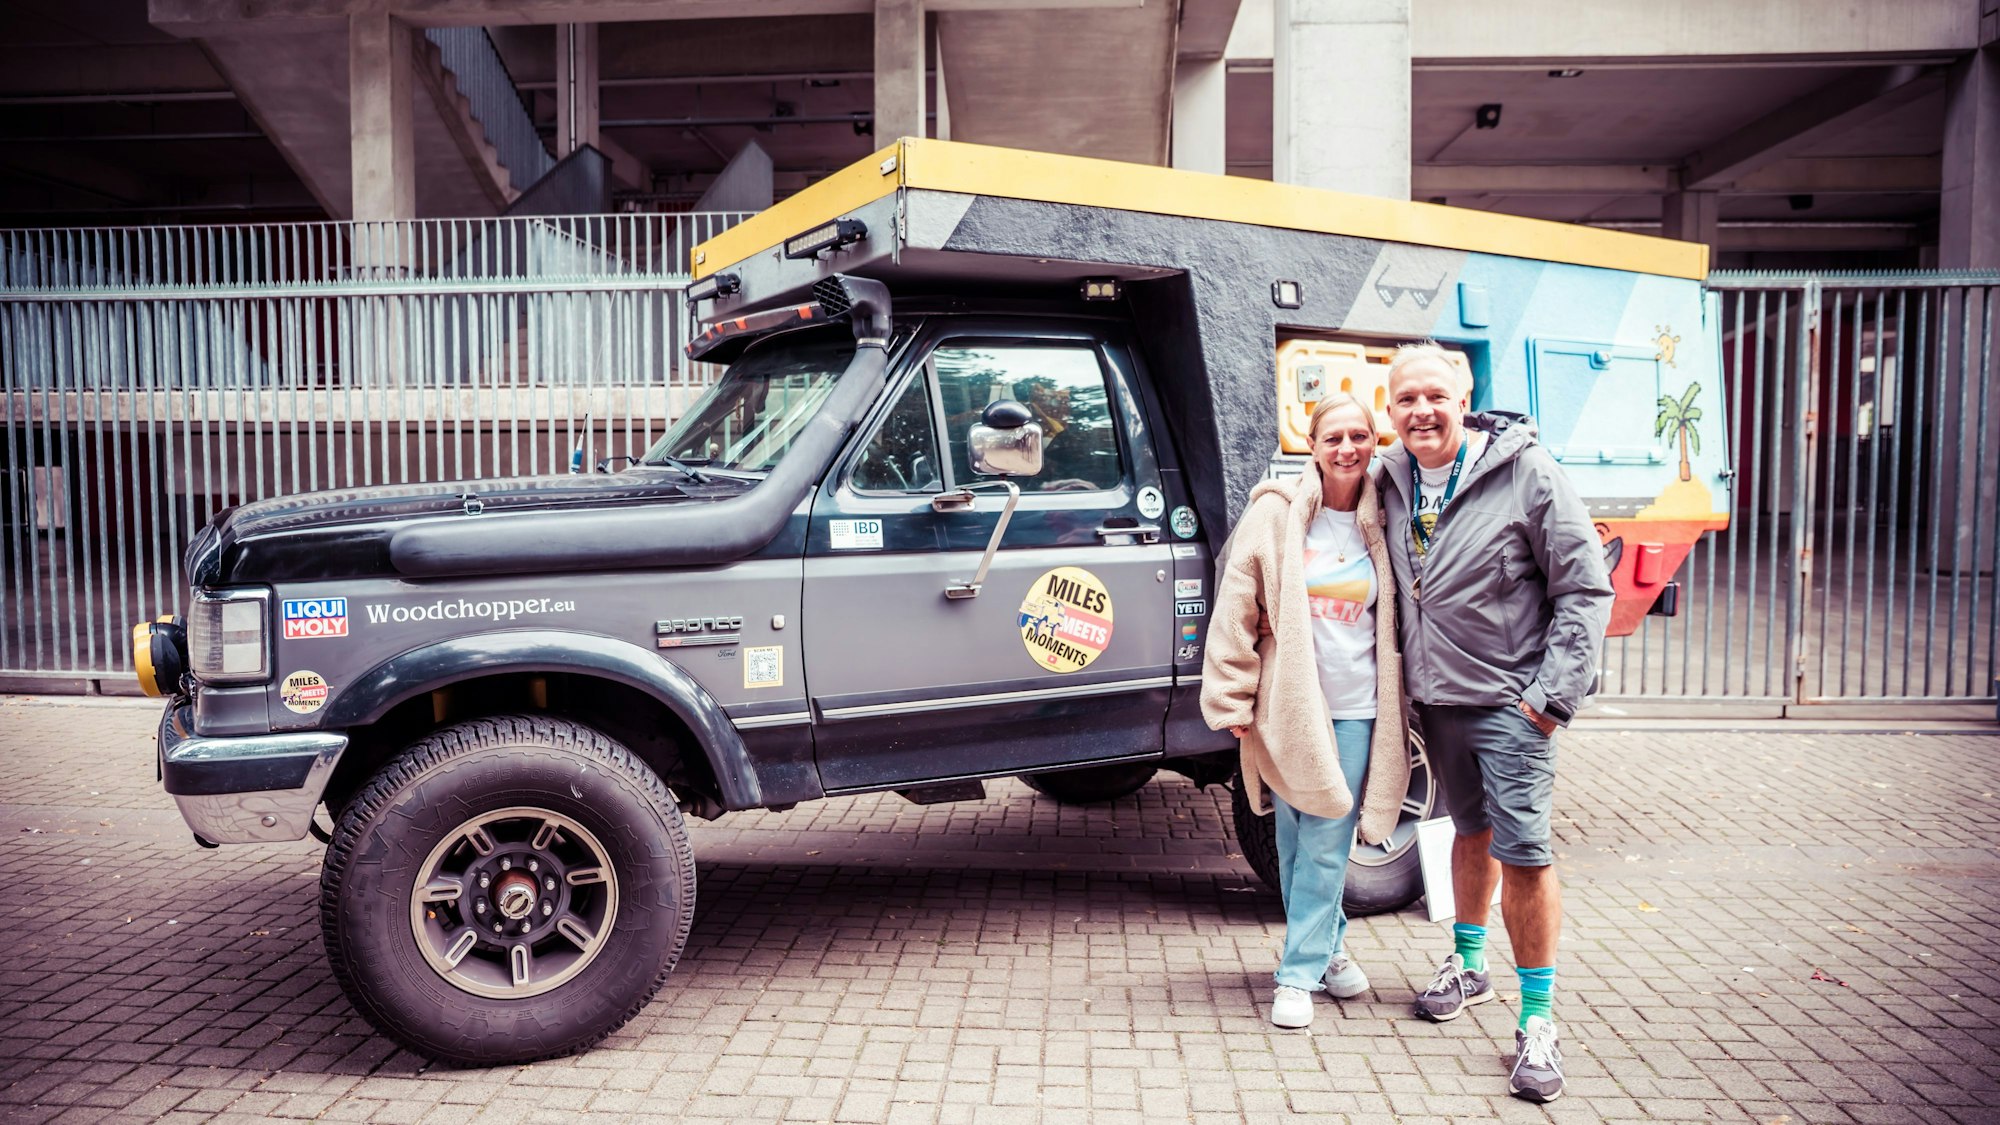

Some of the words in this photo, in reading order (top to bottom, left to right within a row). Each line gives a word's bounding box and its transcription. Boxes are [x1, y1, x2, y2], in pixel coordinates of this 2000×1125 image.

[1452, 462, 1461, 477] YETI
[854, 521, 879, 535] IBD
[1046, 574, 1107, 614] MILES
[286, 600, 344, 619] LIQUI
[366, 597, 576, 624] Woodchopper.eu
[1177, 603, 1204, 614] YETI
[1309, 596, 1363, 622] ÖLN
[287, 618, 346, 637] MOLY
[656, 616, 744, 634] BRONCO
[1060, 615, 1108, 645] MEETS
[1025, 627, 1088, 667] MOMENTS
[289, 676, 320, 688] MILES
[301, 687, 326, 697] MEETS
[288, 699, 321, 707] MOMENTS
